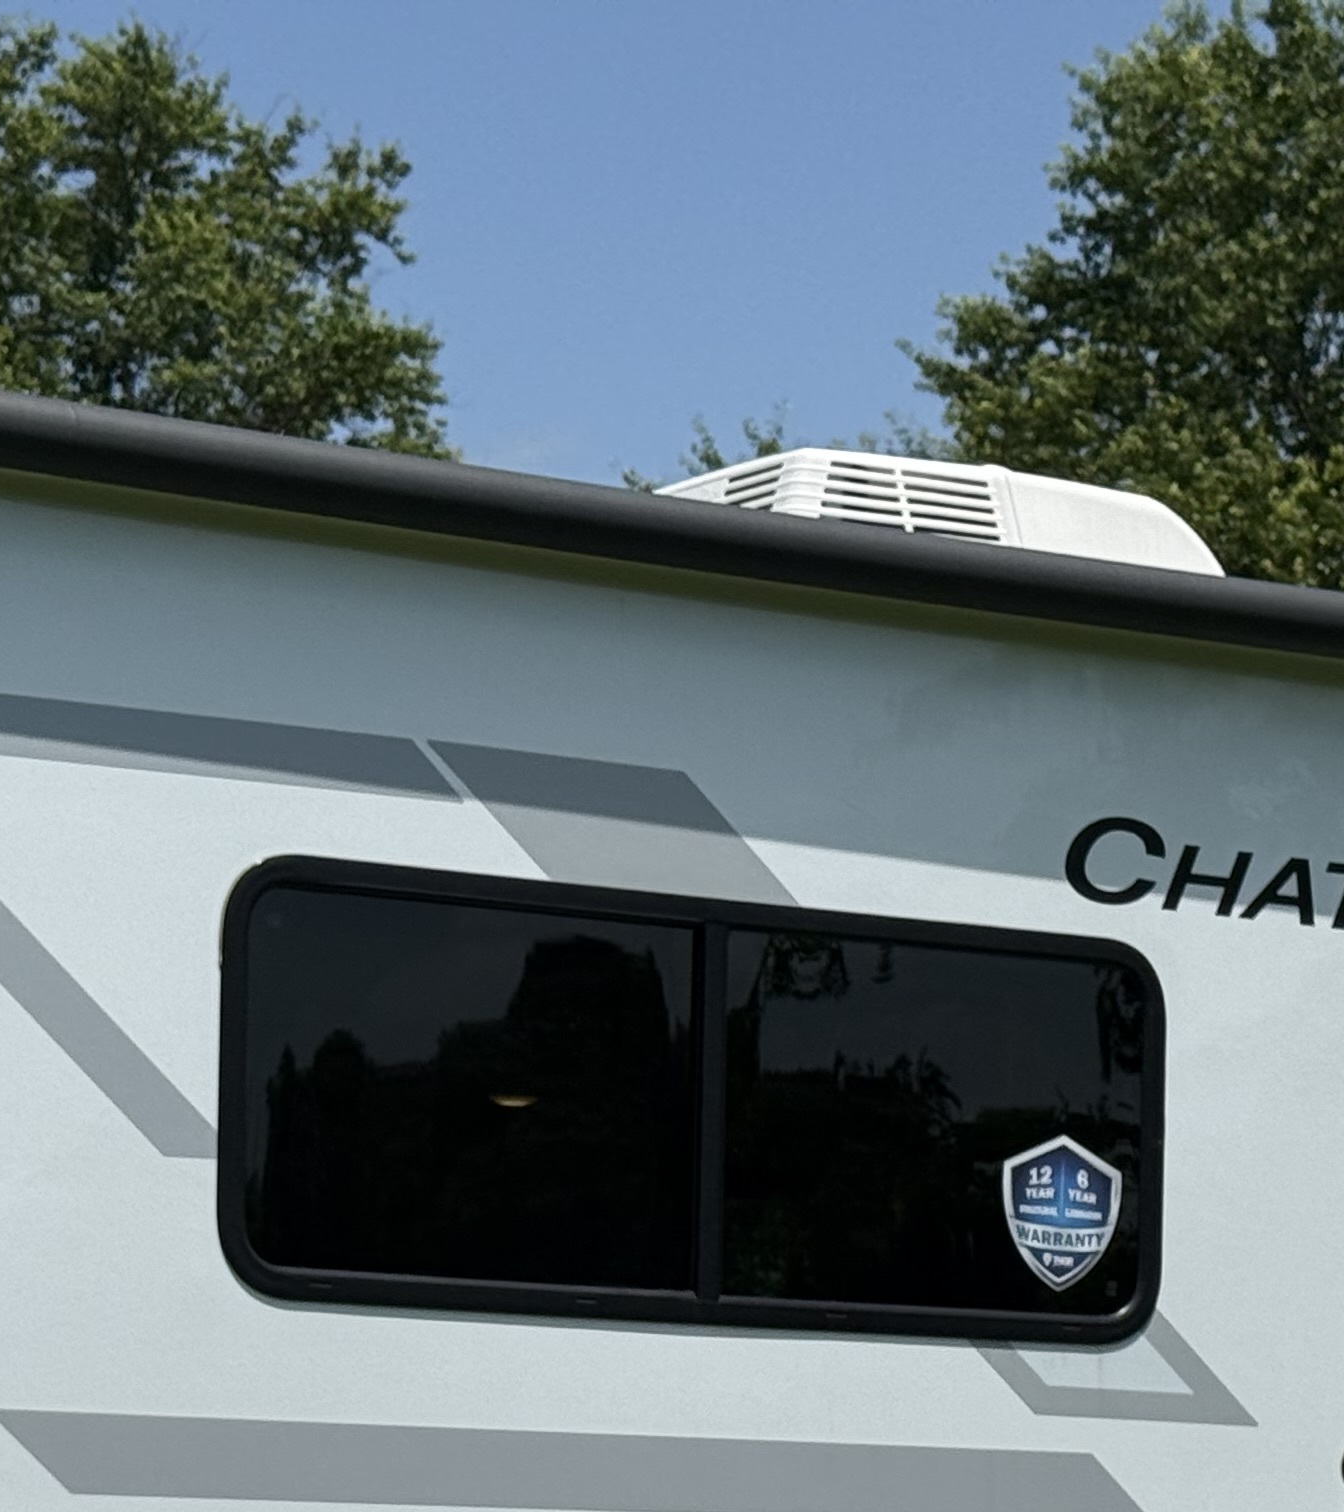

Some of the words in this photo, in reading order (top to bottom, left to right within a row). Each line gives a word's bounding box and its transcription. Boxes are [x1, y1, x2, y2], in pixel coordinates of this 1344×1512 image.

[1028, 1165, 1053, 1186] 12
[1025, 1187, 1055, 1200] YEAR
[1067, 1189, 1097, 1206] YEAR
[1015, 1223, 1106, 1248] WARRANTY
